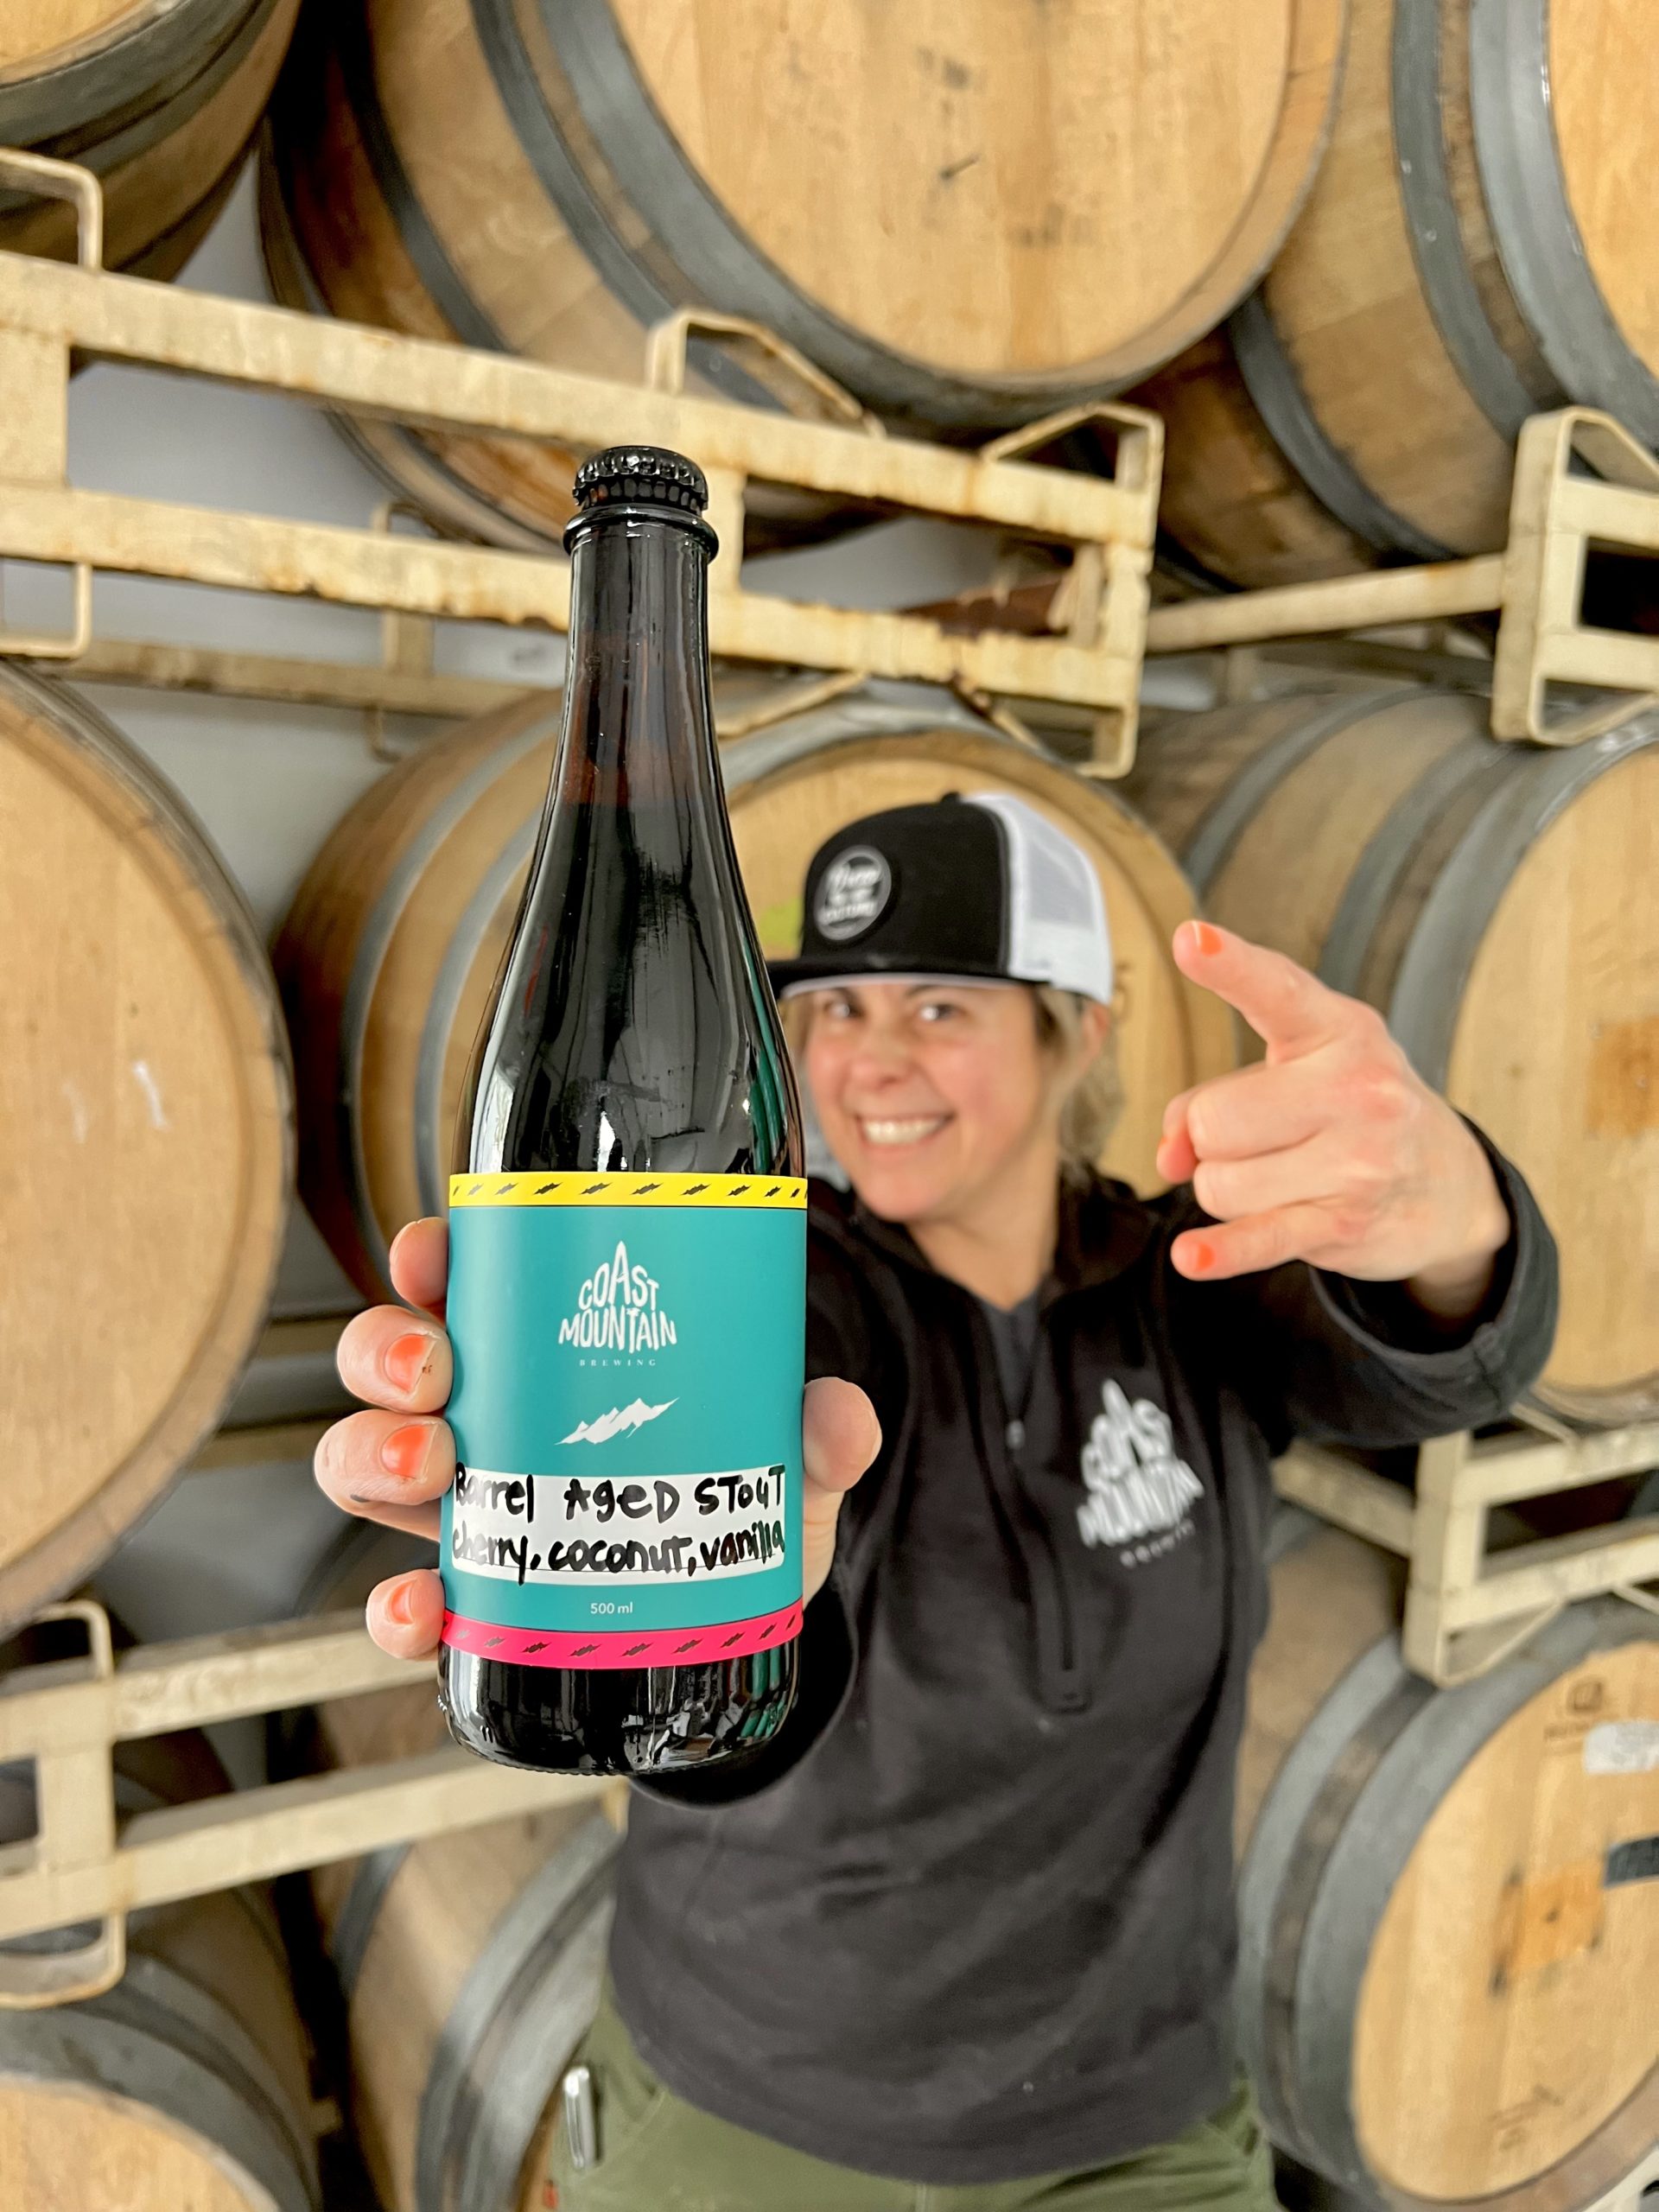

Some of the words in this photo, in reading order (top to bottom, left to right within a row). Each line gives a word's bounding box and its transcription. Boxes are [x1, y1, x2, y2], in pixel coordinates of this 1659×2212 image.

[578, 1241, 659, 1312] COAST
[558, 1305, 677, 1354] MOUNTAIN
[455, 1462, 534, 1523] Barrel
[700, 1520, 785, 1570] vanilla
[590, 1602, 614, 1614] 500
[618, 1601, 632, 1613] ml
